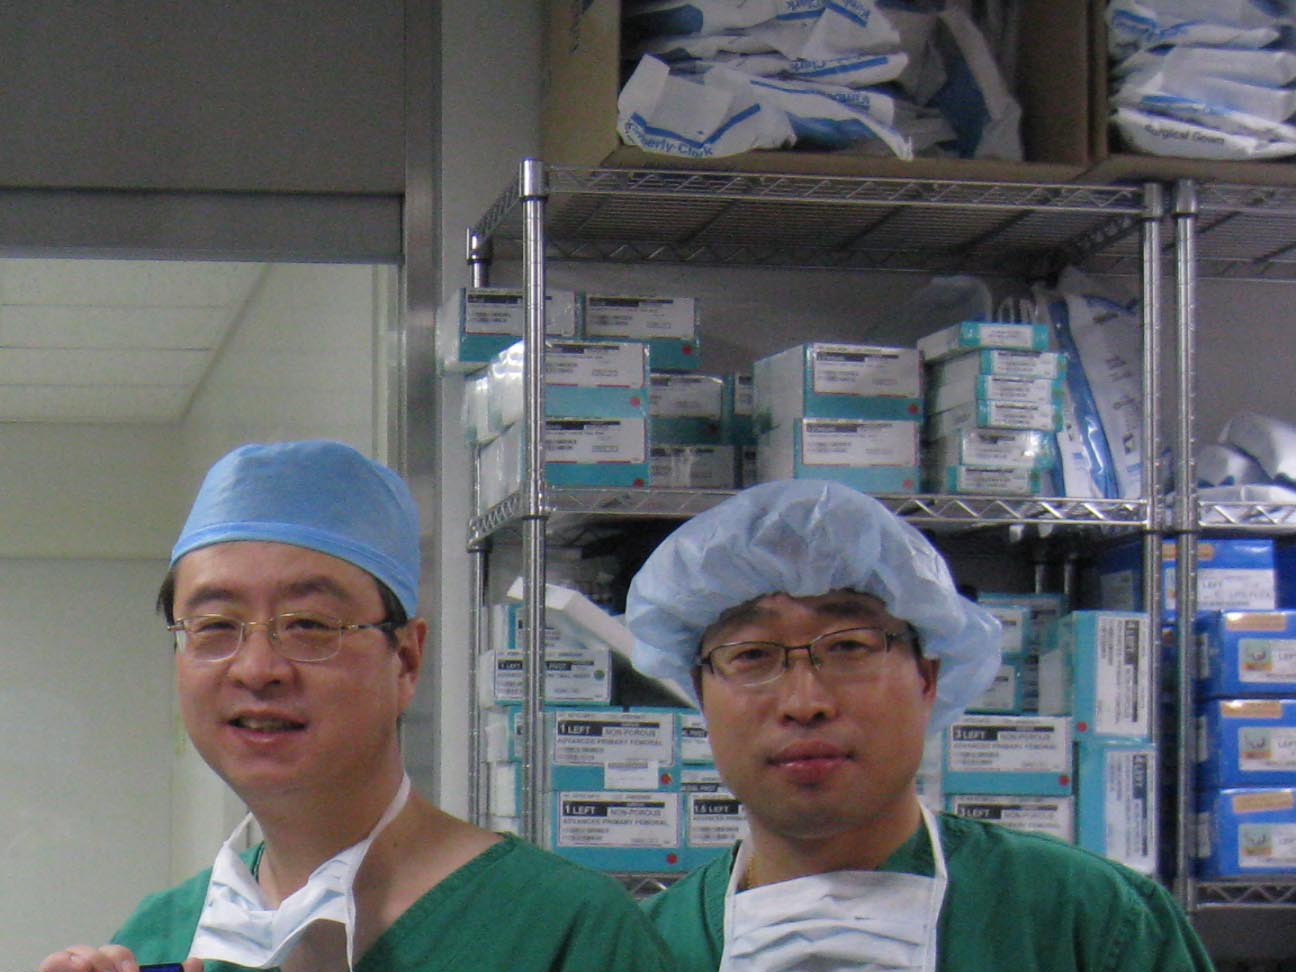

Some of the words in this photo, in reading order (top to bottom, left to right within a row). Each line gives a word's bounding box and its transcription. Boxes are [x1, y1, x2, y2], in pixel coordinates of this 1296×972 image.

[567, 725, 591, 735] LEFT
[572, 805, 596, 814] LEFT
[709, 804, 729, 813] LEFT
